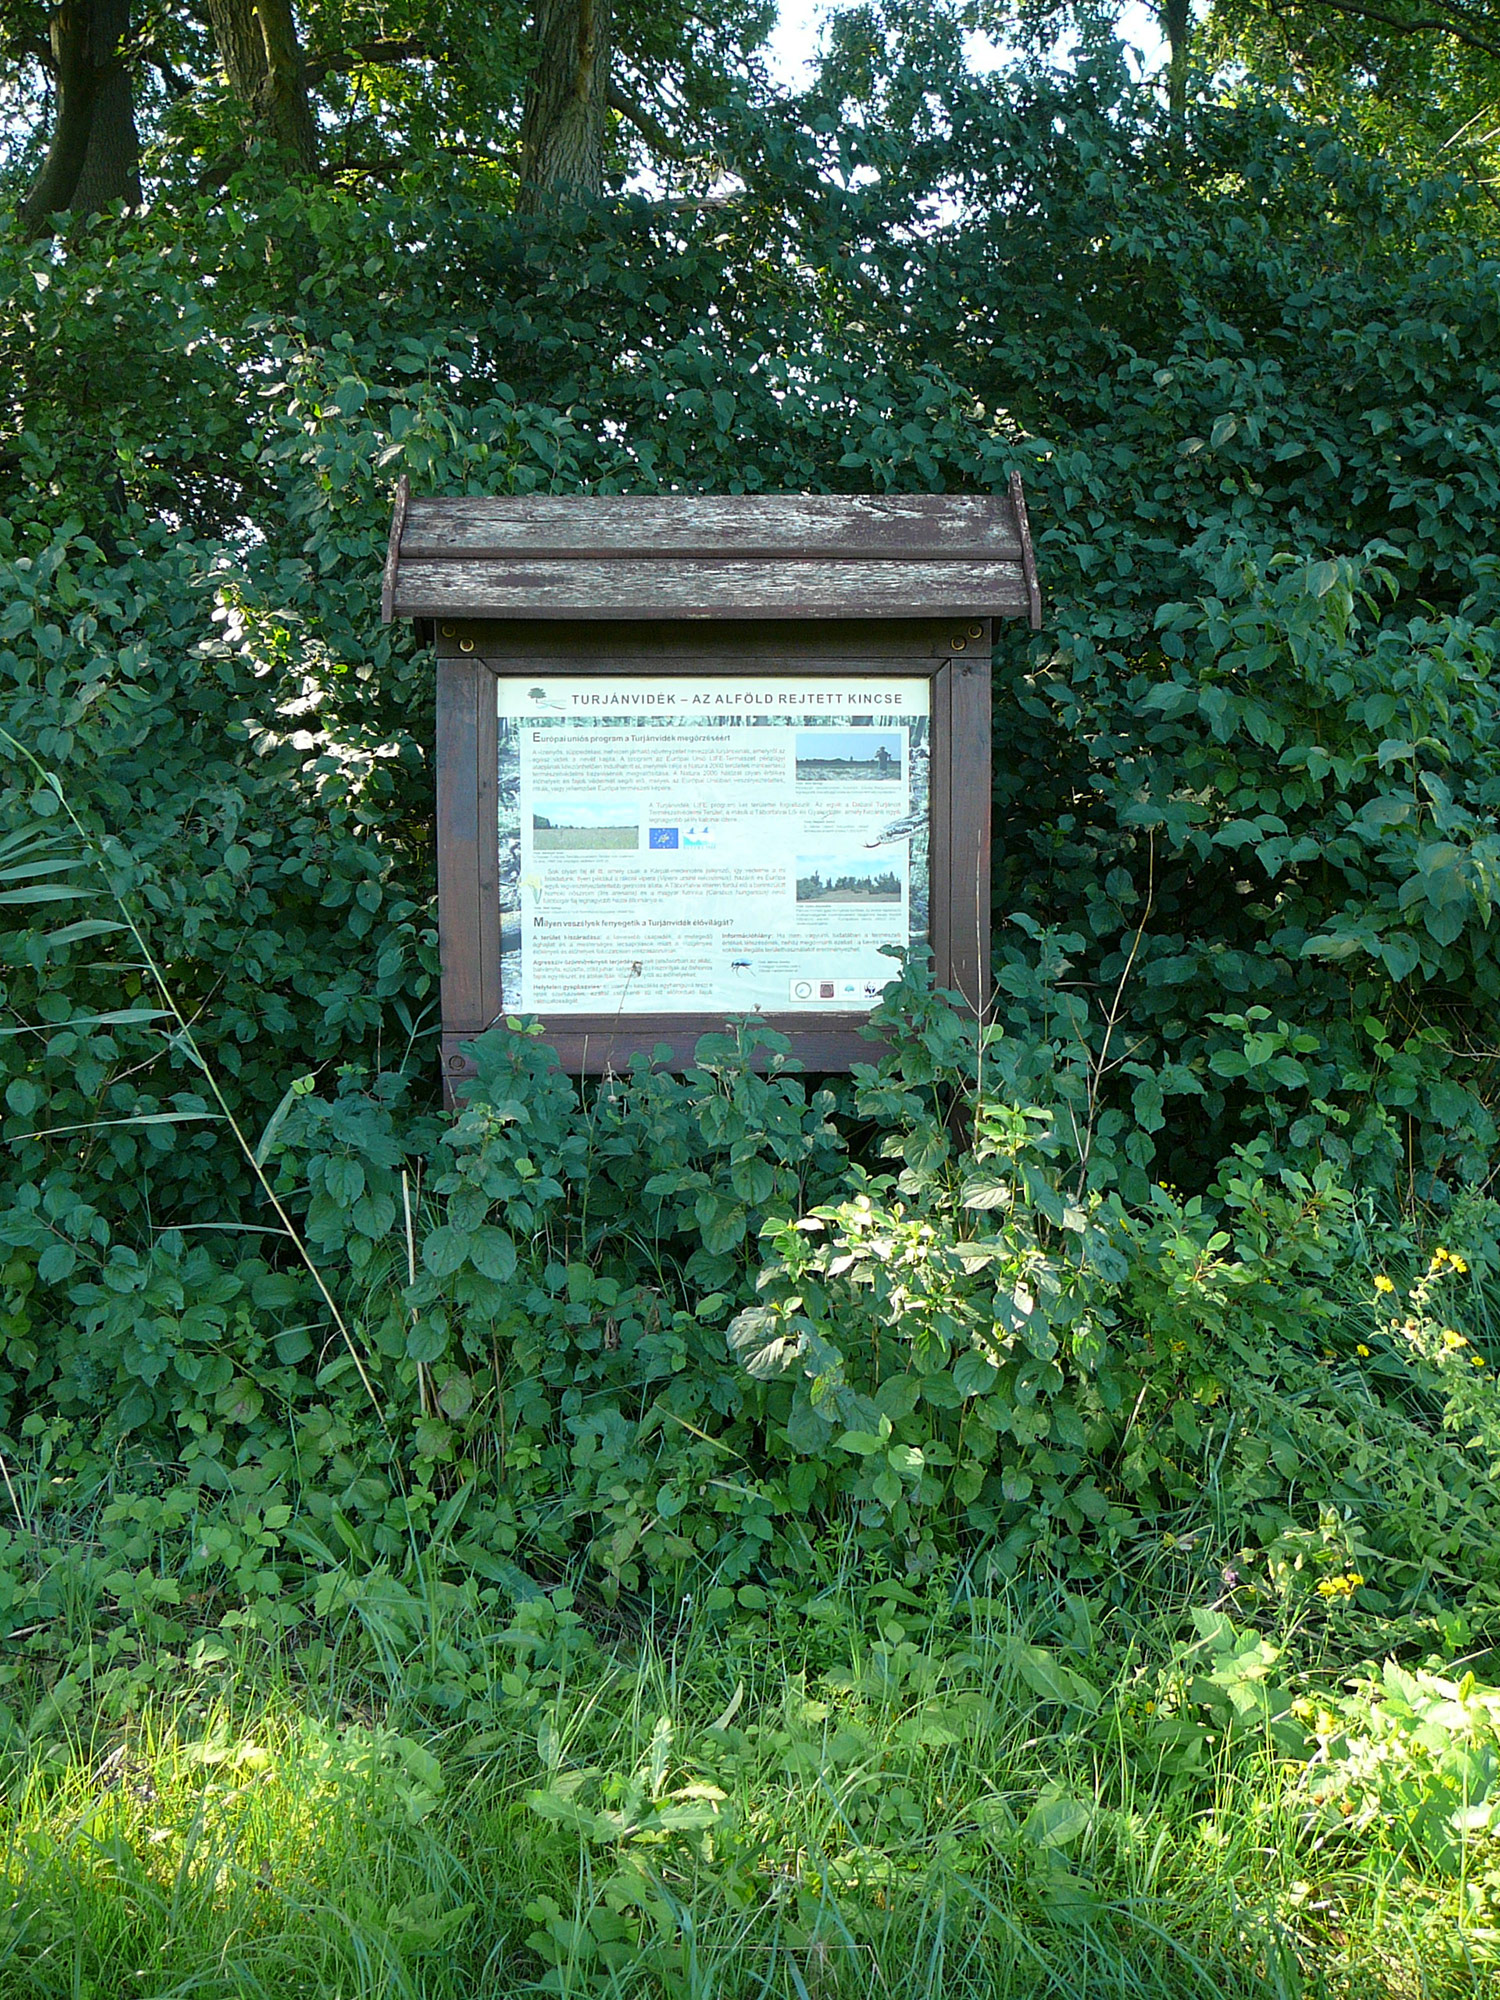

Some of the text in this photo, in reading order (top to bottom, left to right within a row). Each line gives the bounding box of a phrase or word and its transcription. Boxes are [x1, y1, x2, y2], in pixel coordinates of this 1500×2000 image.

[571, 691, 676, 704] TURJÁNVIDÉK
[692, 694, 710, 704] AZ
[714, 691, 773, 704] ALFÖLD
[778, 693, 842, 704] REJTETT
[847, 693, 902, 704] KINCSE
